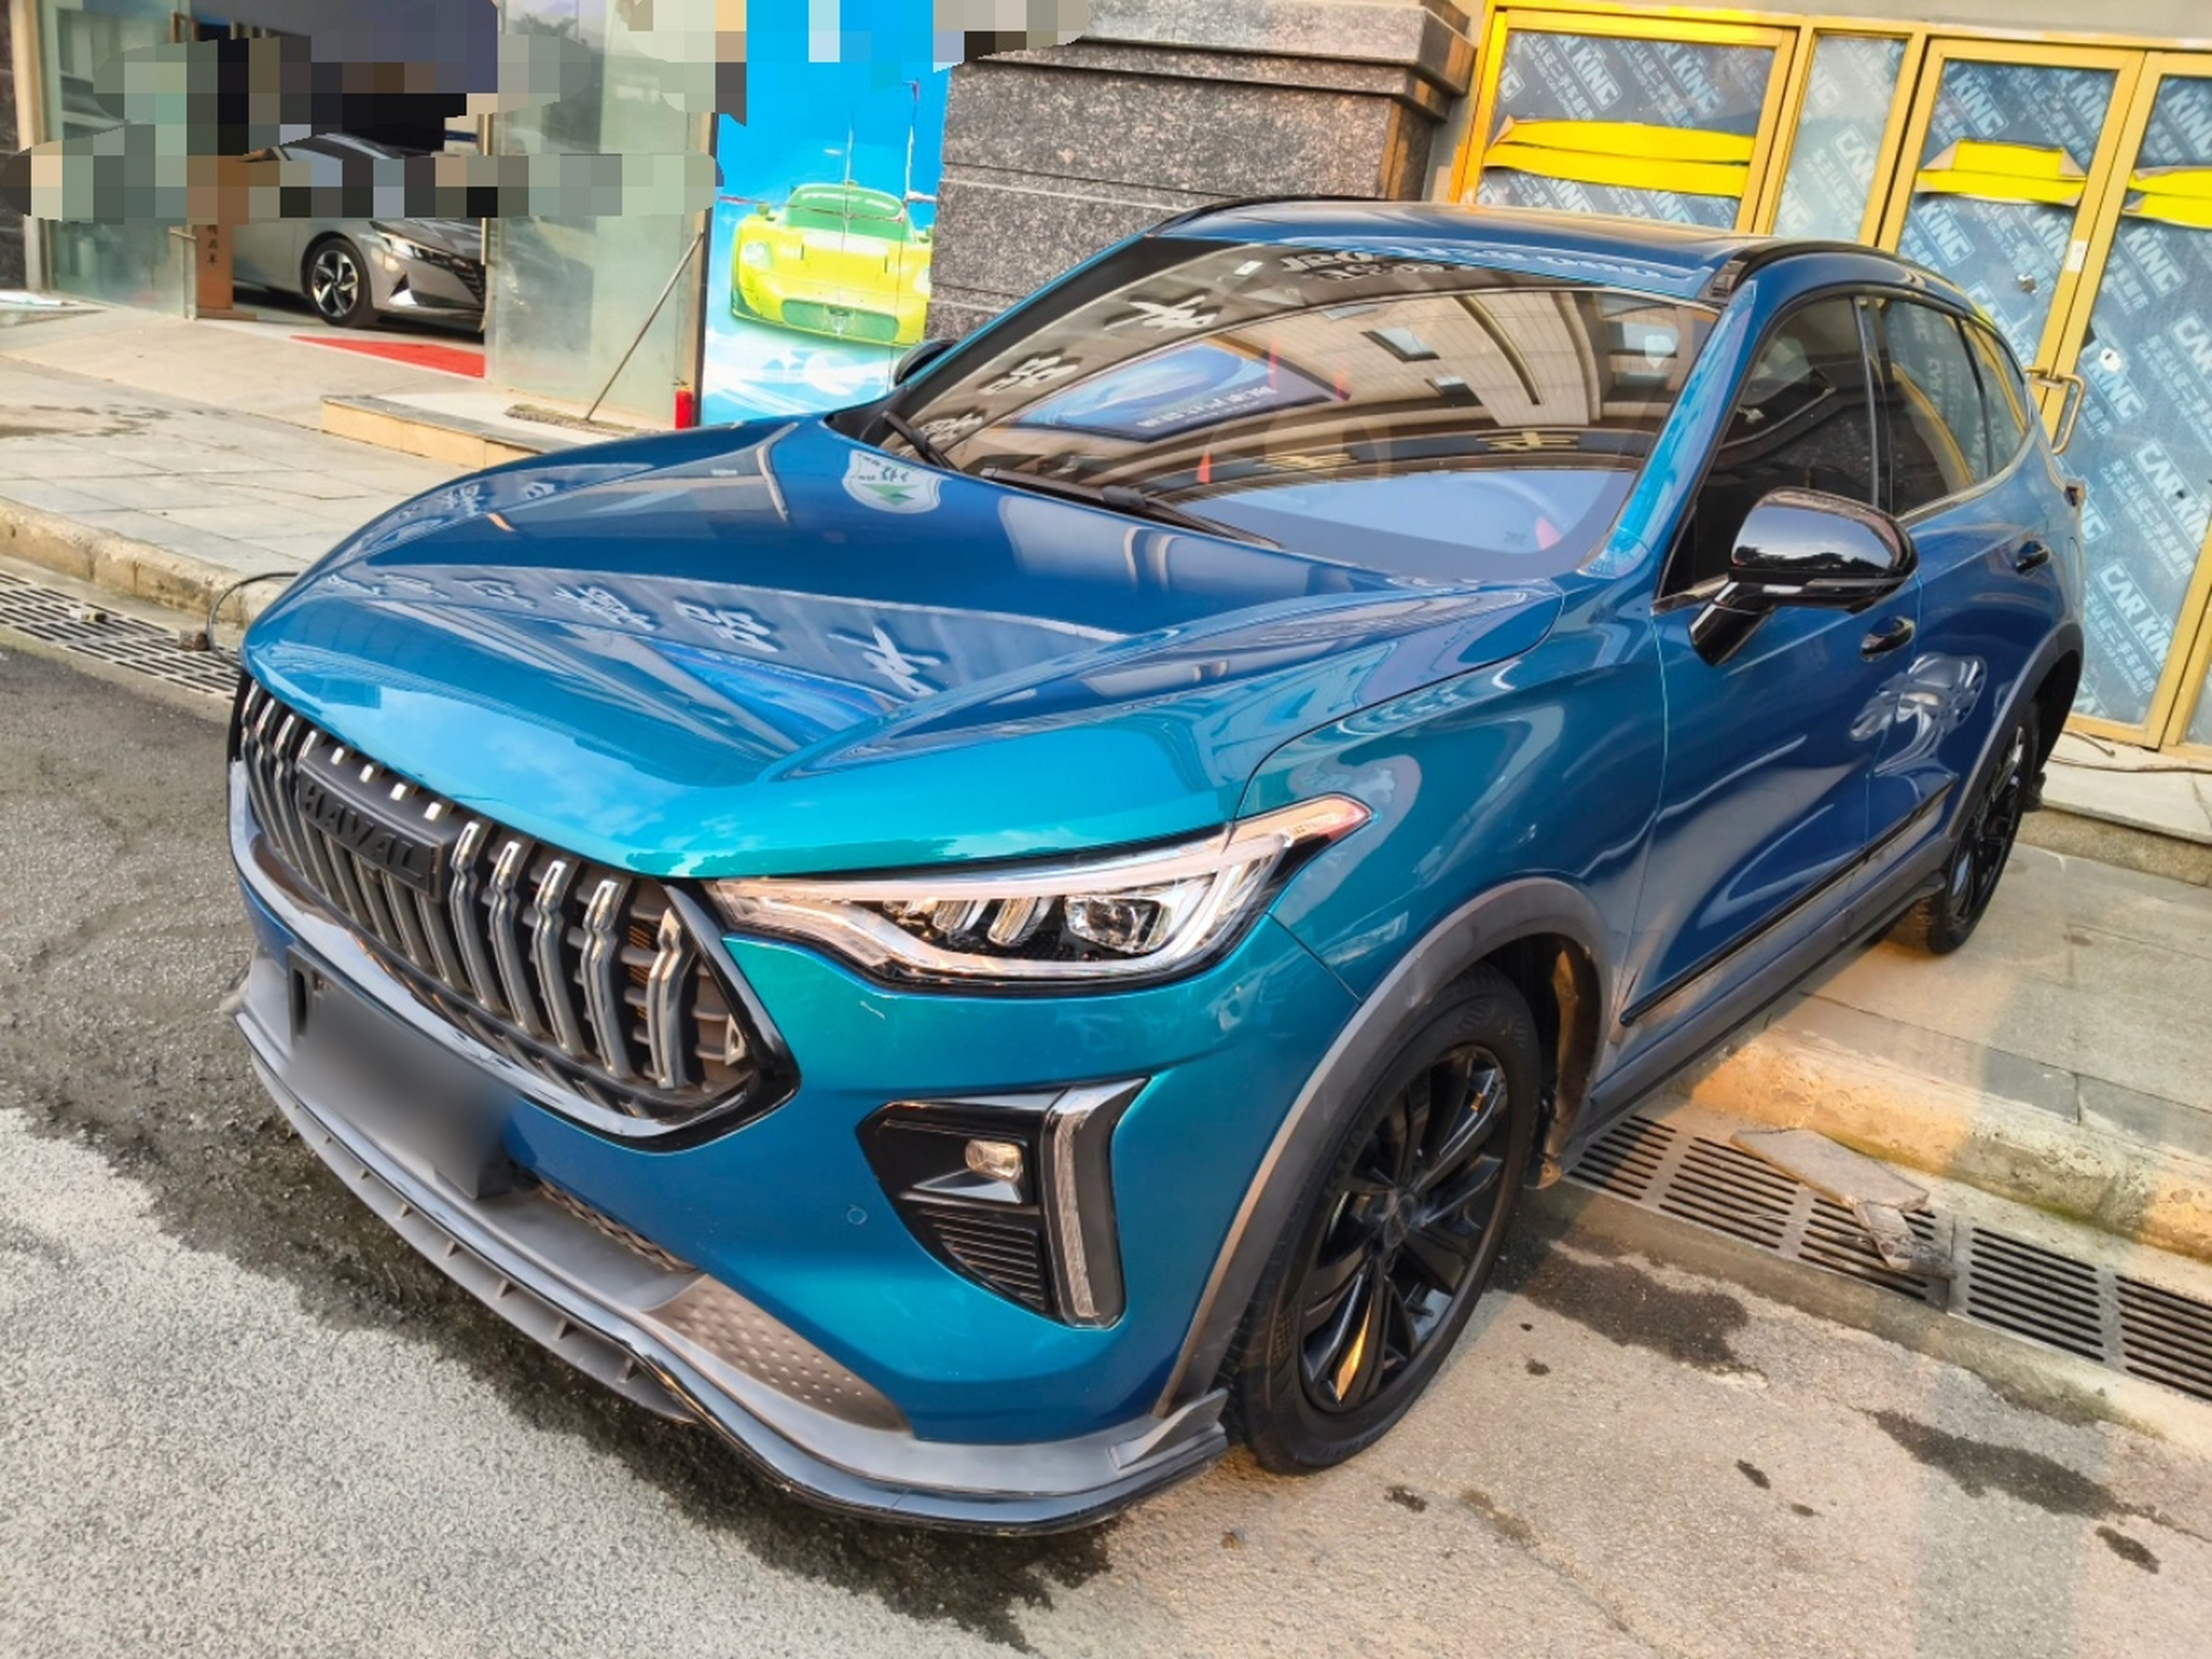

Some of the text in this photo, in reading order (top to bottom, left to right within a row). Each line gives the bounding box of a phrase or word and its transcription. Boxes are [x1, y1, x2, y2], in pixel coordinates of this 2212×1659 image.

[1949, 71, 2005, 136] KING
[1918, 200, 1970, 261] KING
[2125, 227, 2181, 291] KING
[2136, 443, 2184, 499] CAR
[2172, 495, 2210, 543] KIN
[2100, 563, 2171, 663] CAR KIN
[306, 782, 424, 881] HAVAL
